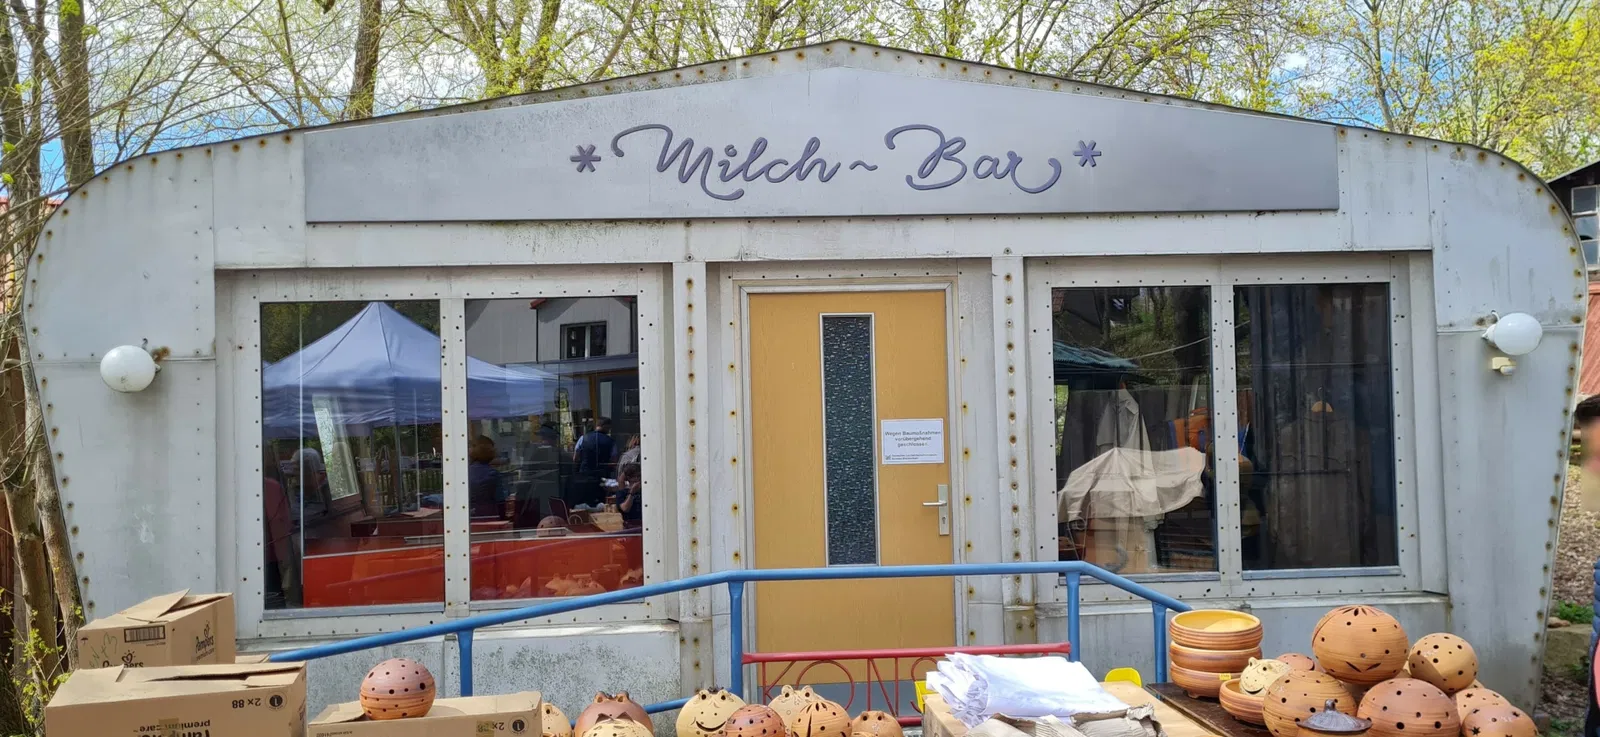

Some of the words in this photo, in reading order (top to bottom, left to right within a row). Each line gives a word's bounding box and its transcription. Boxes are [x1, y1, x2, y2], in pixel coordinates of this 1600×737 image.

[611, 123, 840, 201] Milch
[884, 124, 1062, 194] Bar
[232, 699, 245, 709] 88
